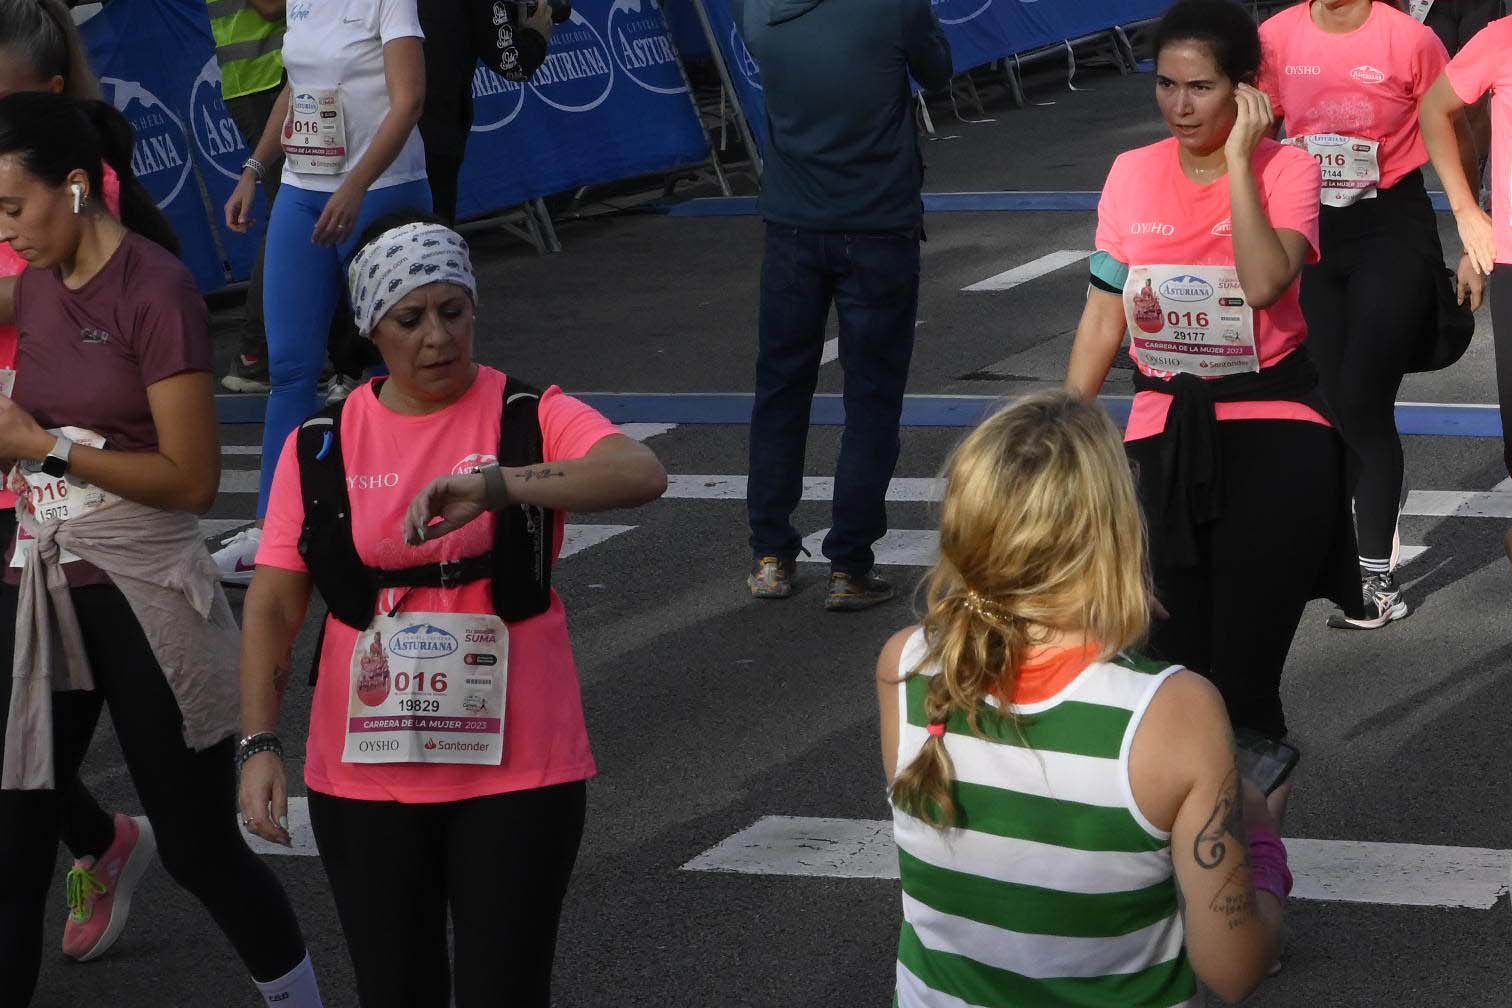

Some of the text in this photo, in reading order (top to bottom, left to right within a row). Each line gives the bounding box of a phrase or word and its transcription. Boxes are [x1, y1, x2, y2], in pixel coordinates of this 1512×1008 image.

[1285, 65, 1321, 75] OYSHO
[294, 120, 318, 133] 016
[1321, 170, 1342, 178] 7144
[1164, 283, 1210, 296] ASTURIANA
[1167, 310, 1209, 327] 016
[1174, 330, 1206, 342] 29177
[1145, 342, 1177, 351] CARRERA
[465, 634, 496, 643] SUMA
[393, 639, 453, 652] ASTURIANA
[394, 671, 448, 693] 016
[398, 699, 440, 713] 19829
[363, 719, 487, 729] CARRERA DE LA MUJER 2023
[359, 739, 490, 752] OYSHO Santander
